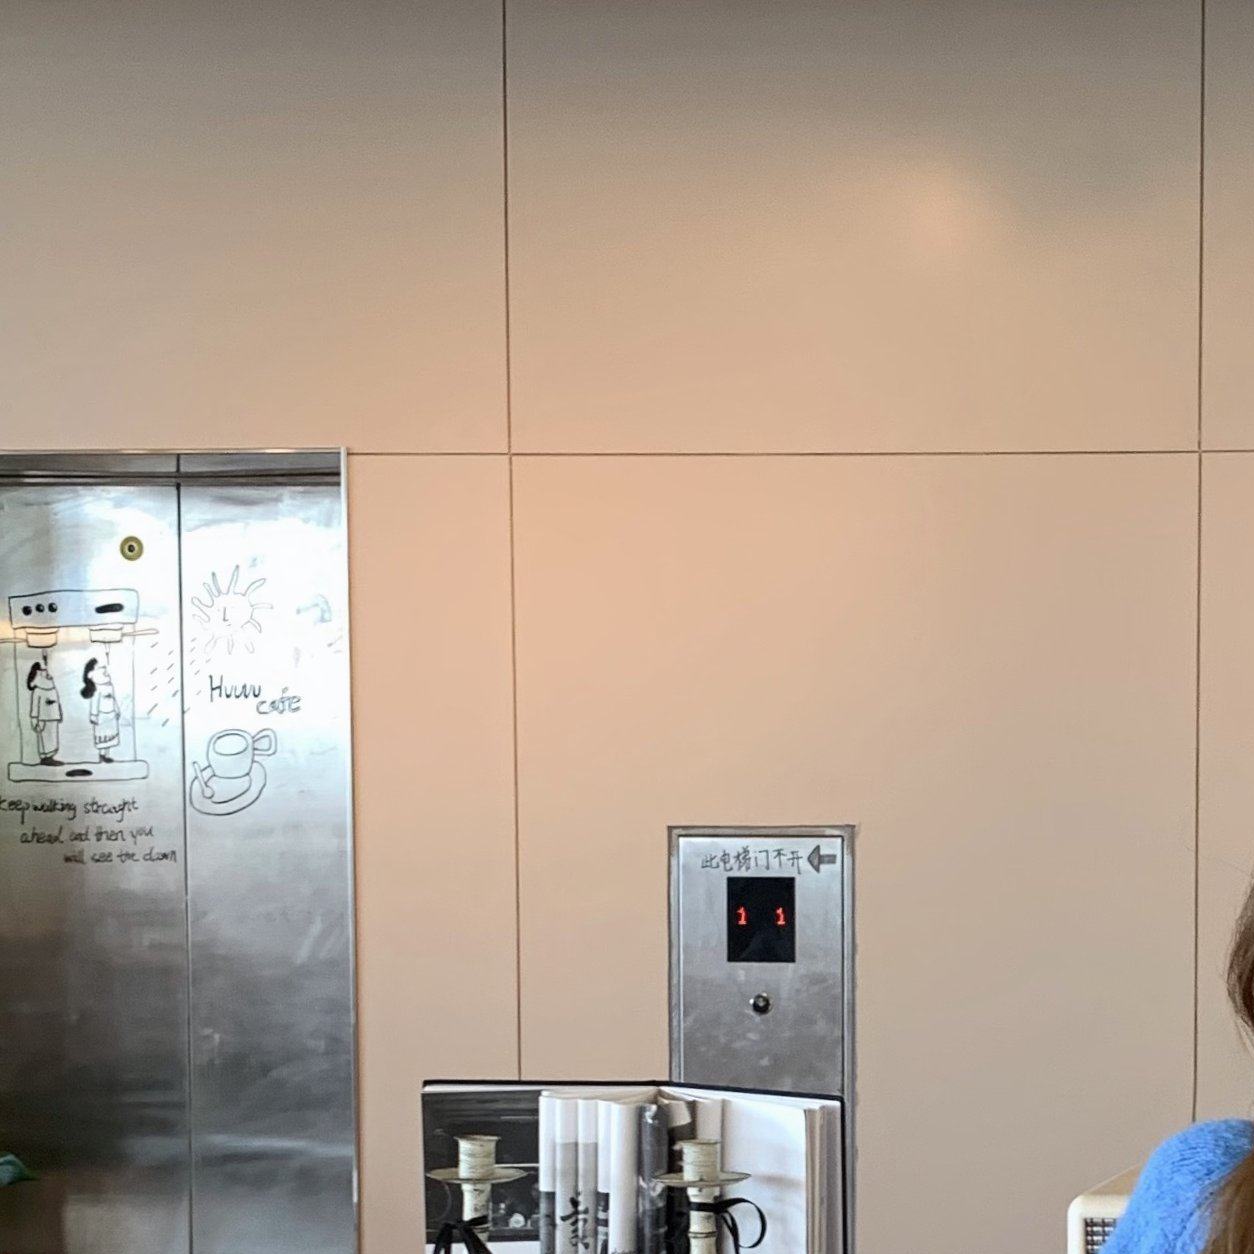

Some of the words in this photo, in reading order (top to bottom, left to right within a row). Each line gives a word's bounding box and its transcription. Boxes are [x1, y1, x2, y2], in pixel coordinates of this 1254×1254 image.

[20, 827, 64, 844] ahead
[95, 826, 126, 842] then
[130, 826, 154, 845] you
[91, 851, 113, 863] see
[117, 849, 139, 863] the
[700, 845, 804, 875] 此电梯门不开
[736, 906, 747, 925] 1
[775, 906, 786, 925] 1
